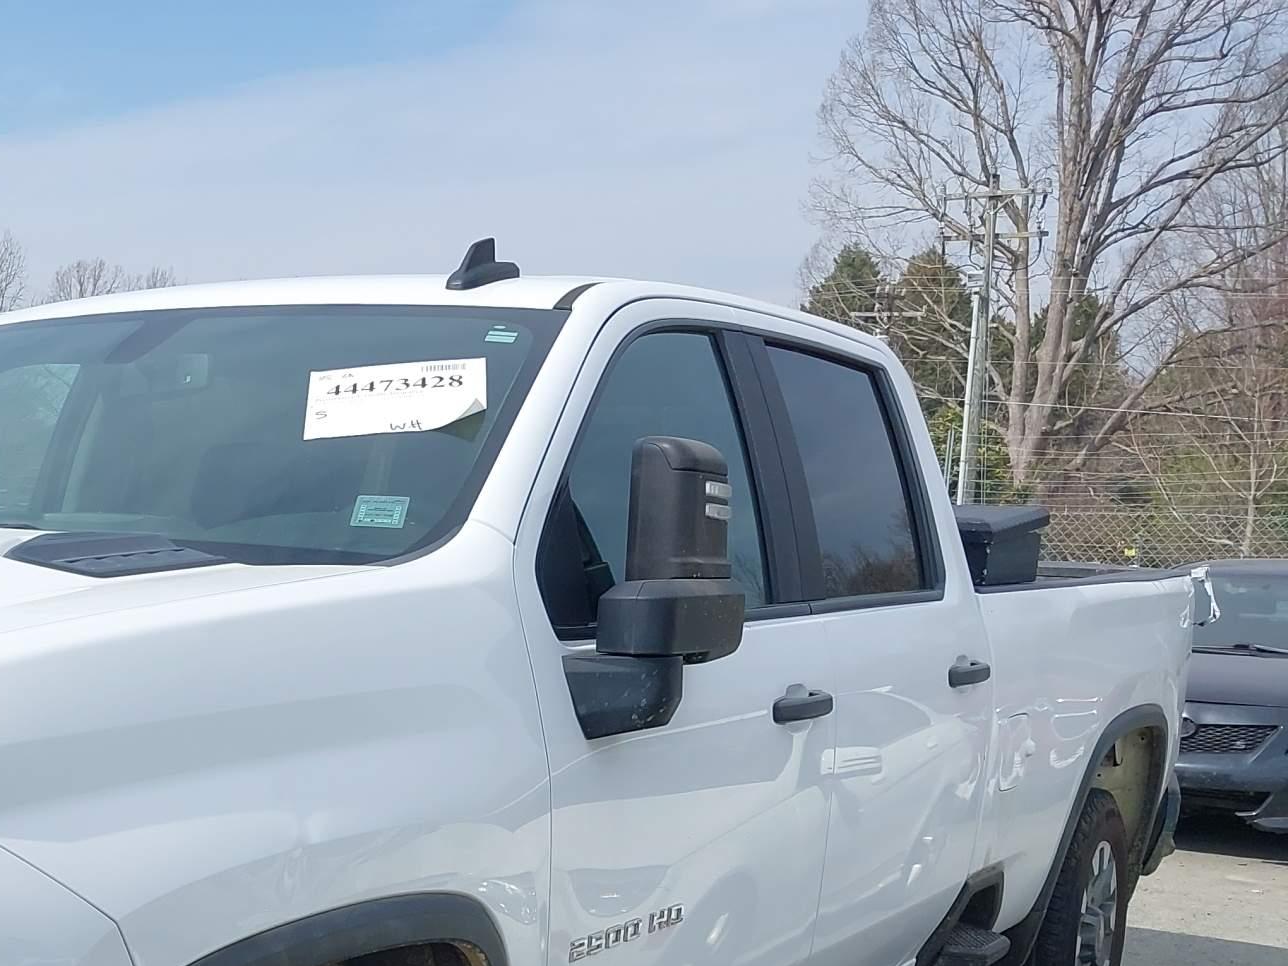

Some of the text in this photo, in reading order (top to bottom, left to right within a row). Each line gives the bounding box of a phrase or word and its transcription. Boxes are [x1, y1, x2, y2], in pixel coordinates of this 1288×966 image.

[326, 374, 464, 396] 44473428
[568, 902, 685, 963] 2500 HD
